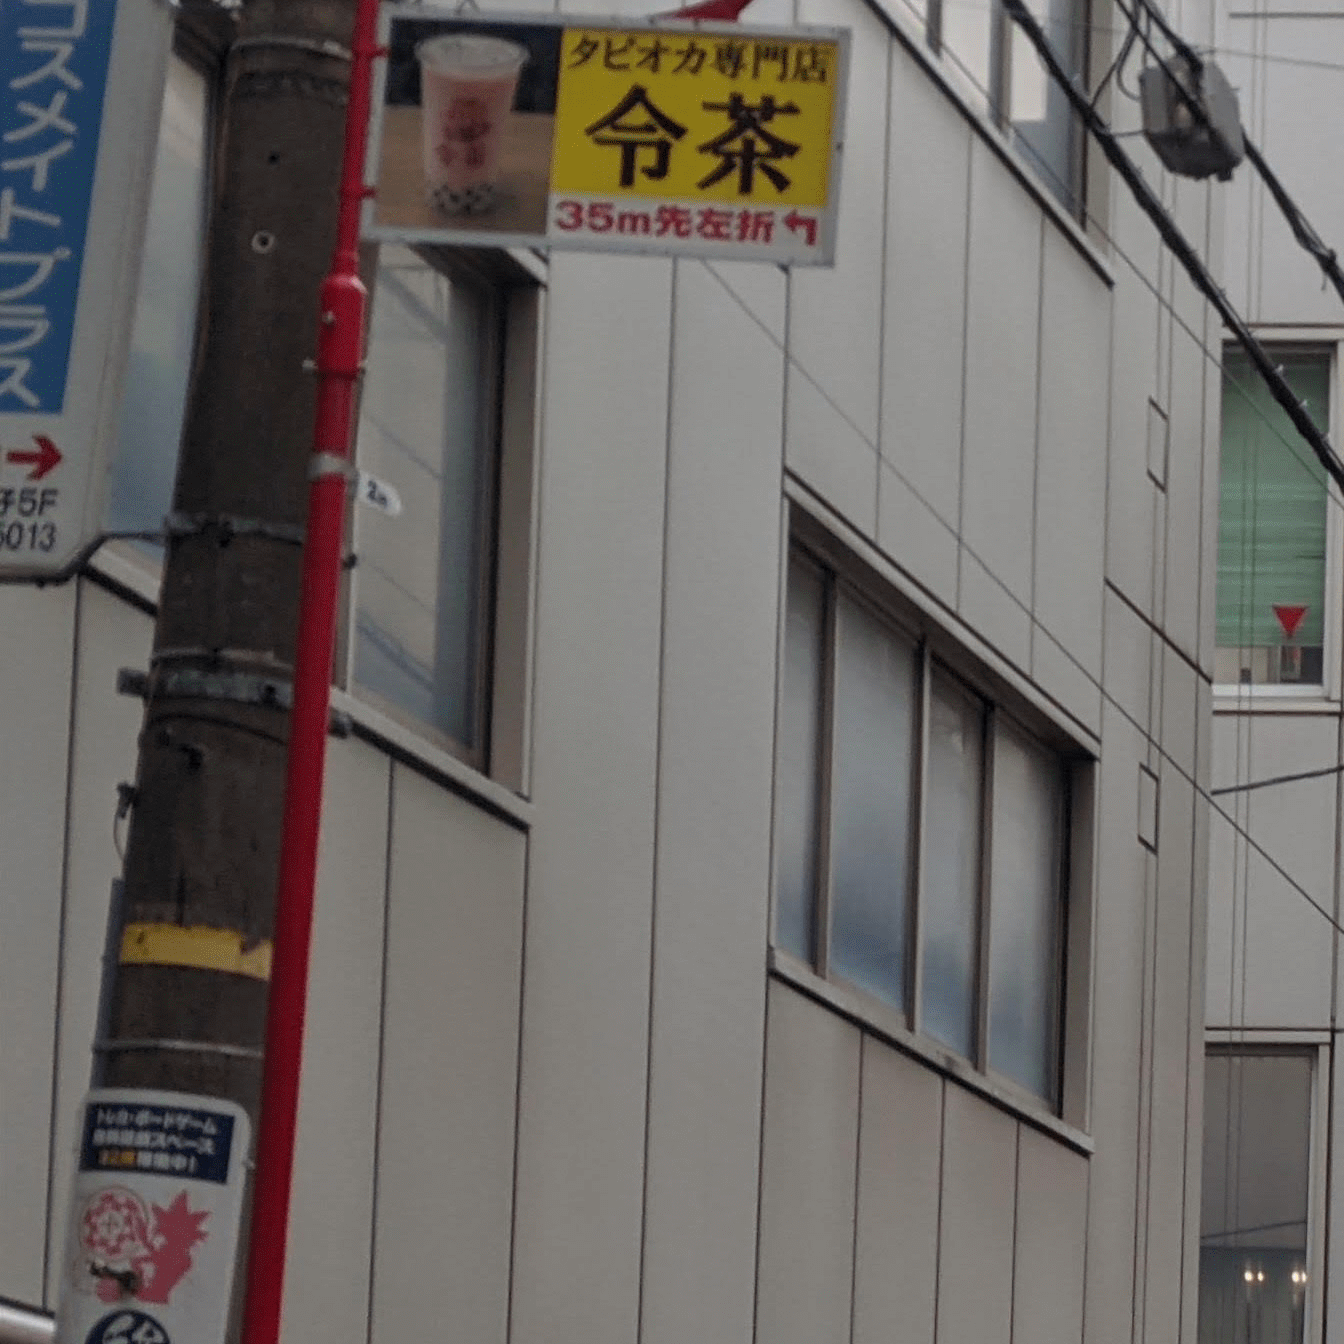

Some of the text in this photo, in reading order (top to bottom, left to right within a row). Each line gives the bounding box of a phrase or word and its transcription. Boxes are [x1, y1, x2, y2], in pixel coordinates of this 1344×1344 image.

[568, 36, 829, 84] タピオカ専門店
[584, 83, 801, 195] 令茶
[555, 200, 774, 244] 35m先左折
